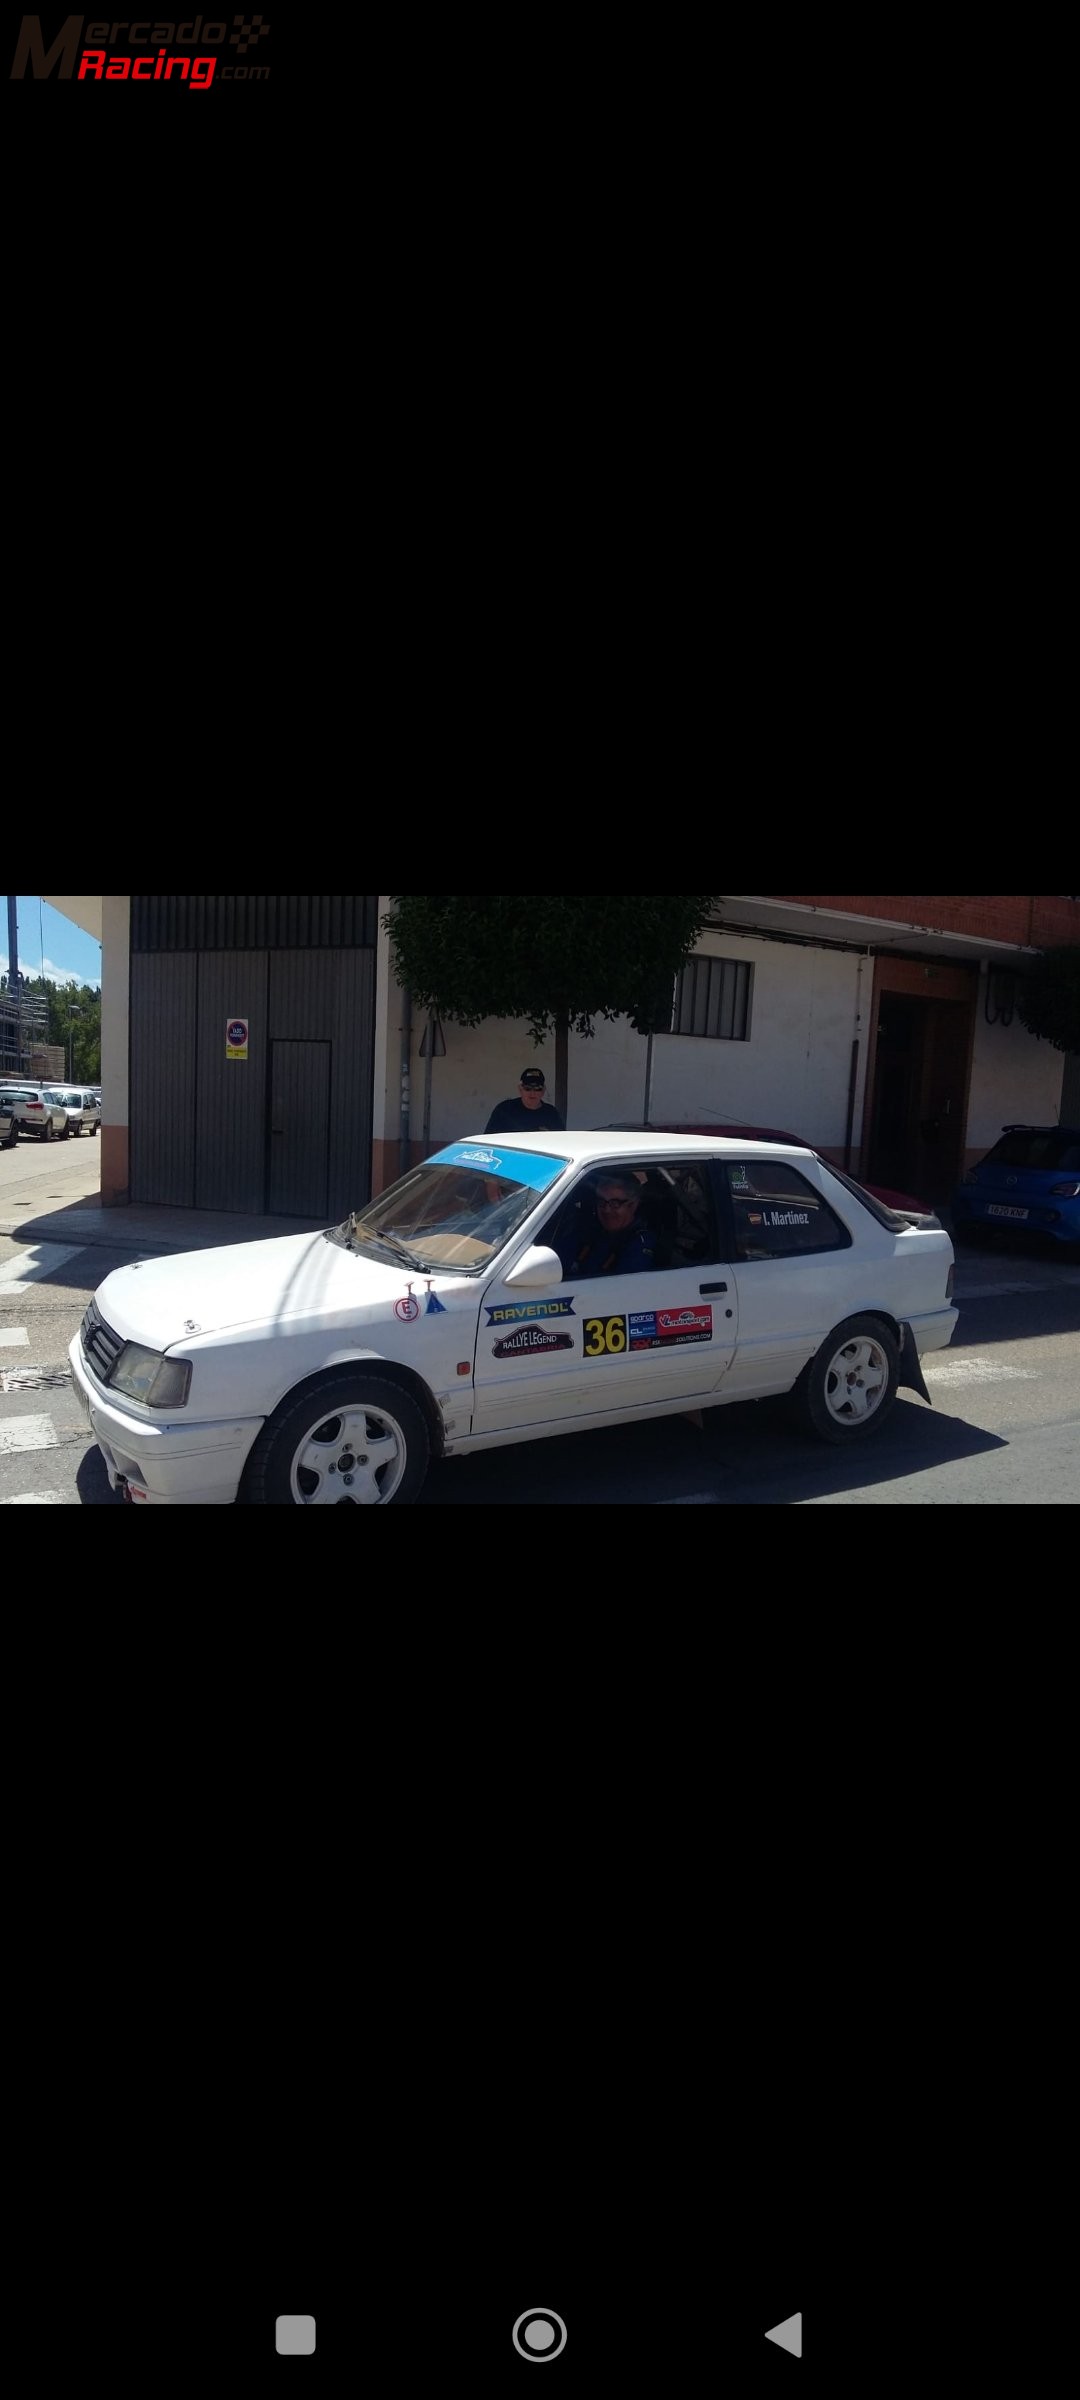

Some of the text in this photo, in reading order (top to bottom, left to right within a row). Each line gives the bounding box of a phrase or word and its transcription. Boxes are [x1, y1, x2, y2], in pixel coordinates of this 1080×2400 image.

[402, 1301, 412, 1314] E
[493, 1303, 569, 1321] RAVENOL
[503, 1331, 557, 1349] RALLYE LEGEND
[585, 1317, 625, 1355] 36
